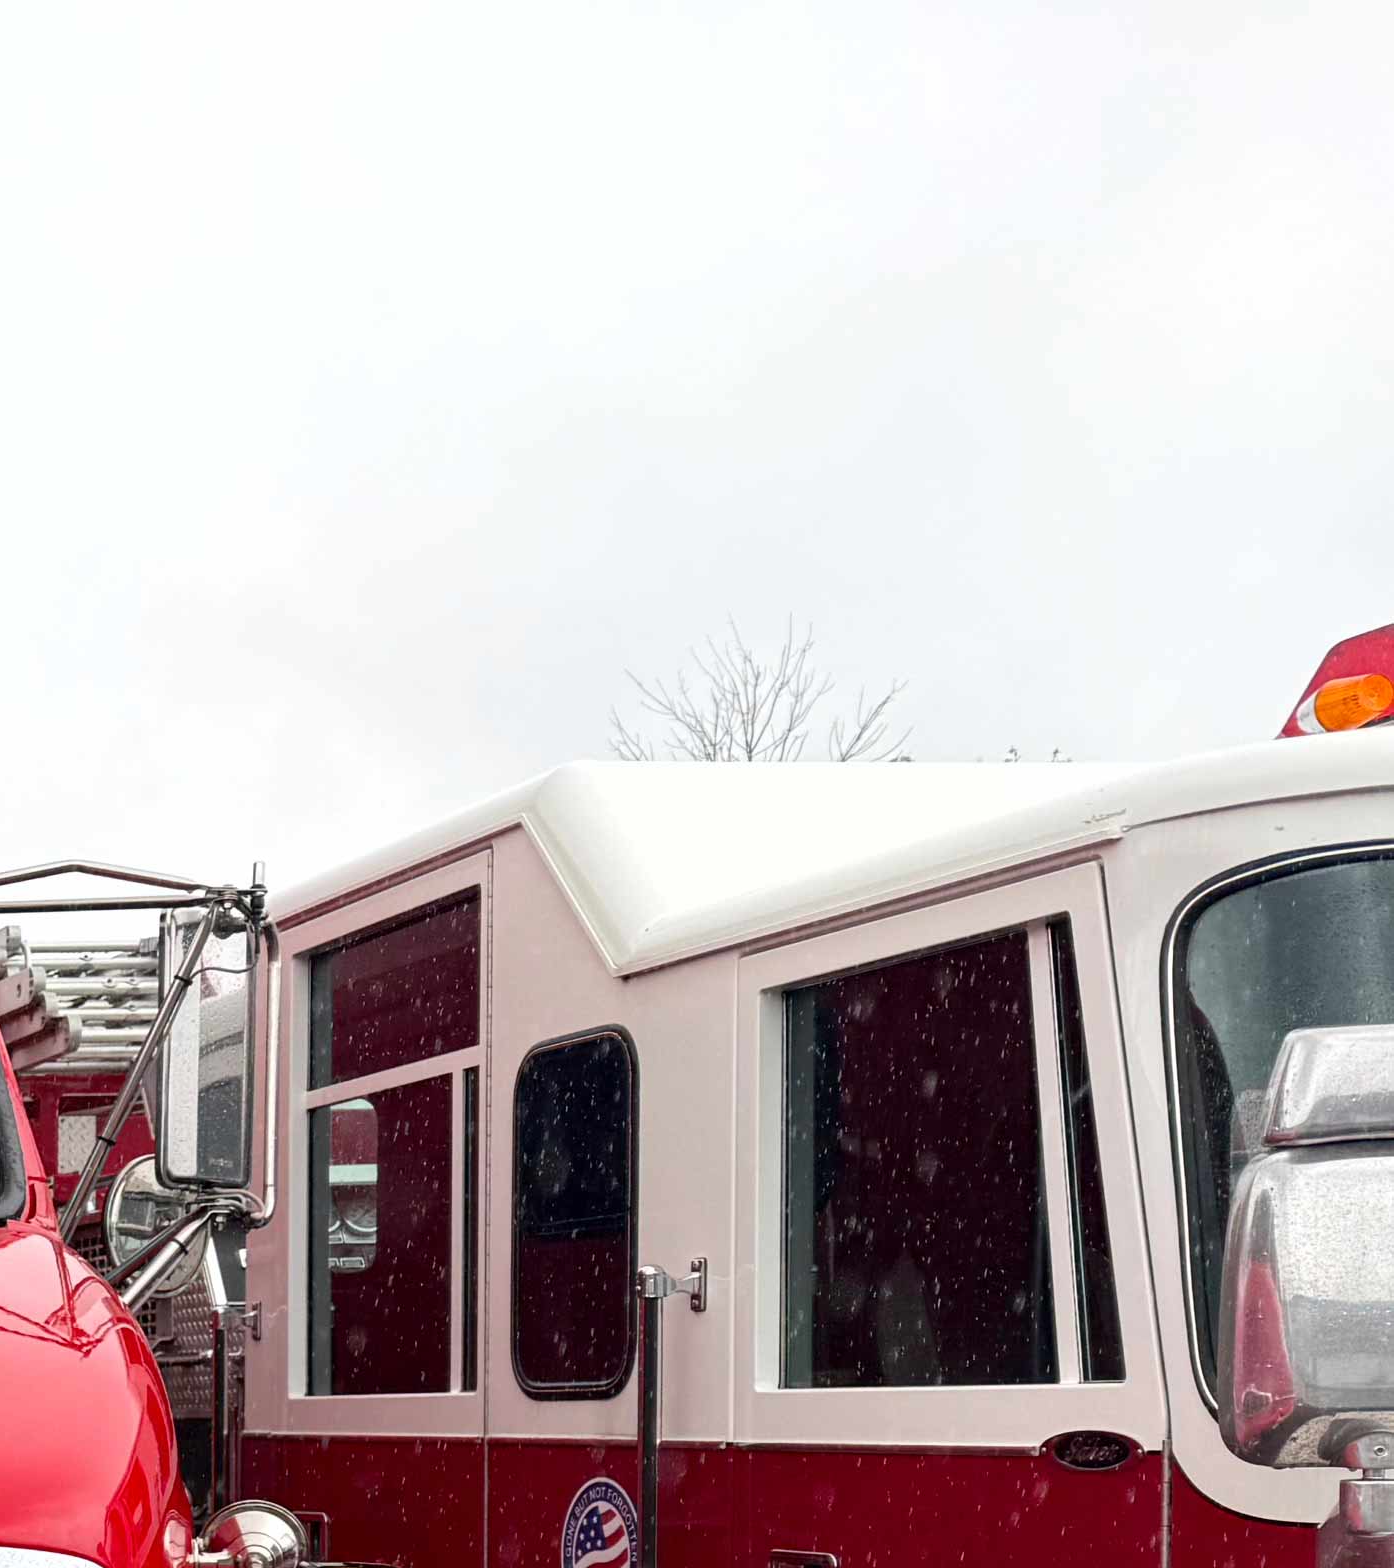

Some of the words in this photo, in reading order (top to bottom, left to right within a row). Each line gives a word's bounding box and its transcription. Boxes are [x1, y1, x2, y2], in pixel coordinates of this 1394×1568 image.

[565, 1517, 577, 1557] GONE
[574, 1494, 589, 1517] BUT
[589, 1487, 605, 1500] NOT
